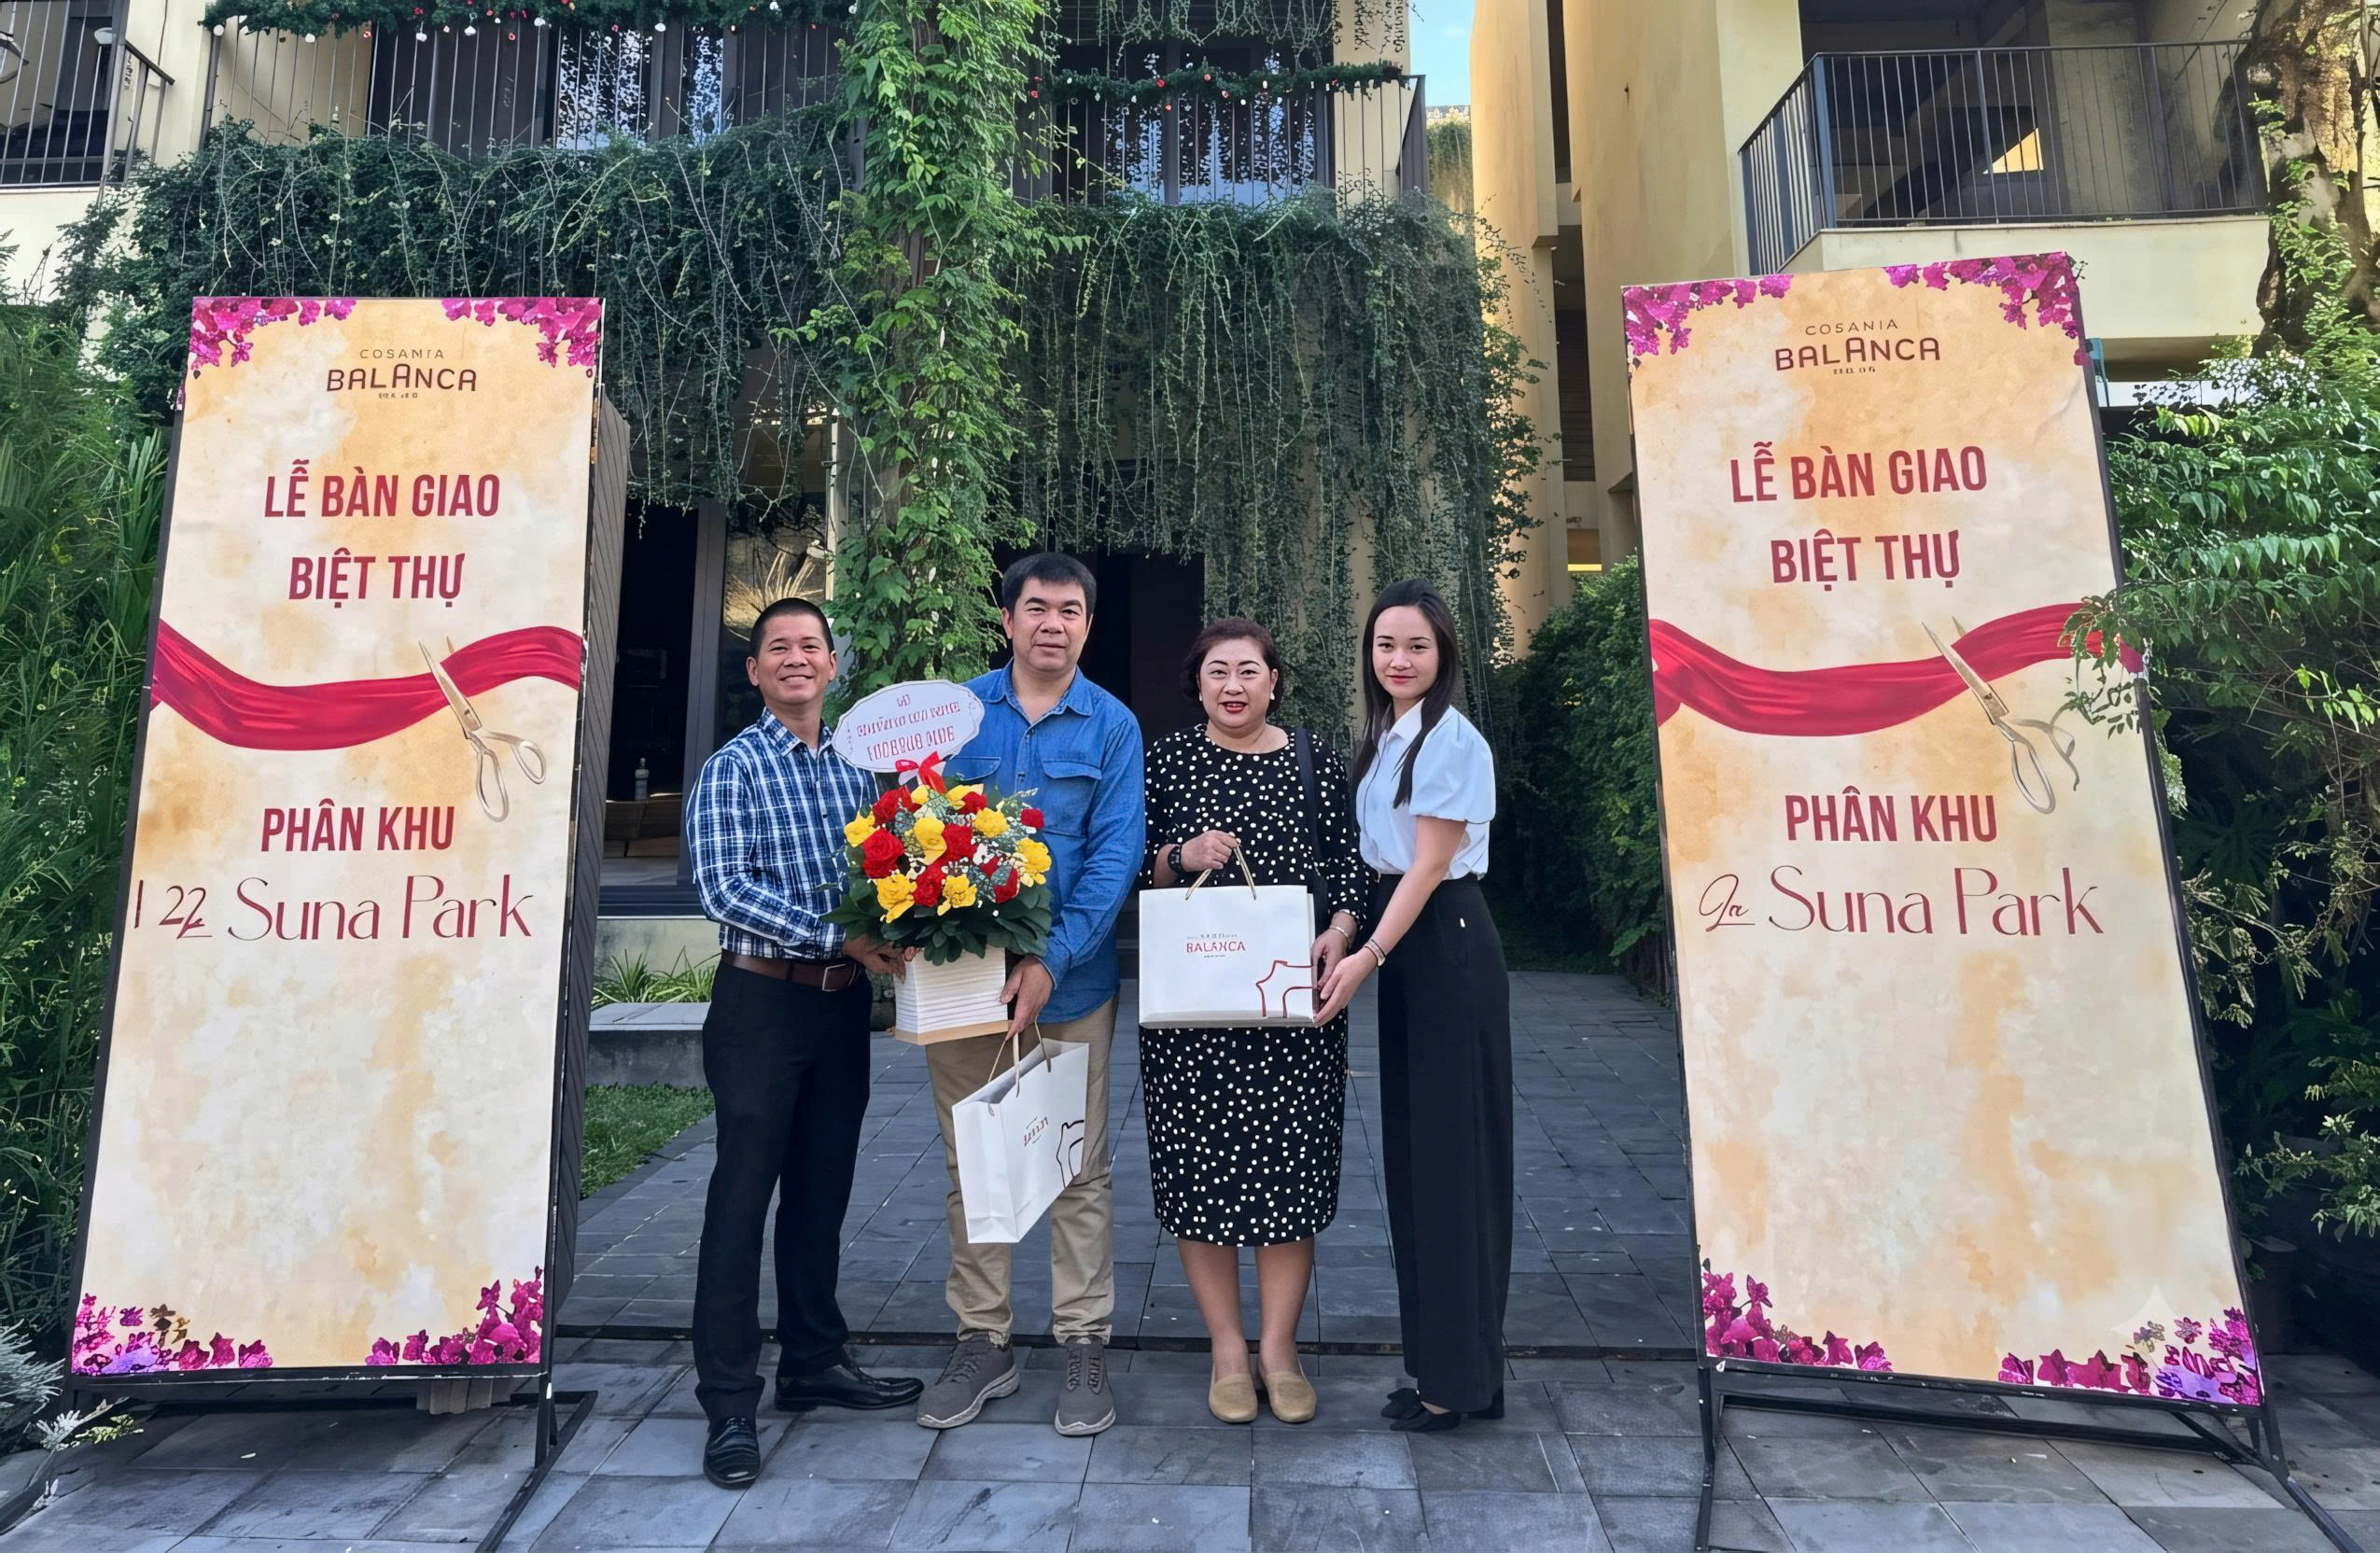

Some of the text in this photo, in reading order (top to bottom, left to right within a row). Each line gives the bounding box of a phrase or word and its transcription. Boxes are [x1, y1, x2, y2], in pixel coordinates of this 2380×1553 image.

[327, 363, 477, 392] BALANCA
[1775, 337, 1941, 371] BALANCA
[264, 459, 500, 517] LỄ BÀN GIAO
[1730, 441, 1987, 502] LỄ BÀN GIAO
[288, 547, 466, 609] BIỆT THỰ
[1771, 528, 1960, 592] BIỆT THỰ
[260, 797, 455, 852] PHÂN KHU
[1785, 785, 1997, 843] PHÂN KHU
[227, 877, 380, 941] Suna
[401, 874, 534, 939] Park
[1769, 864, 1933, 934] Suna
[1953, 867, 2104, 936] Park
